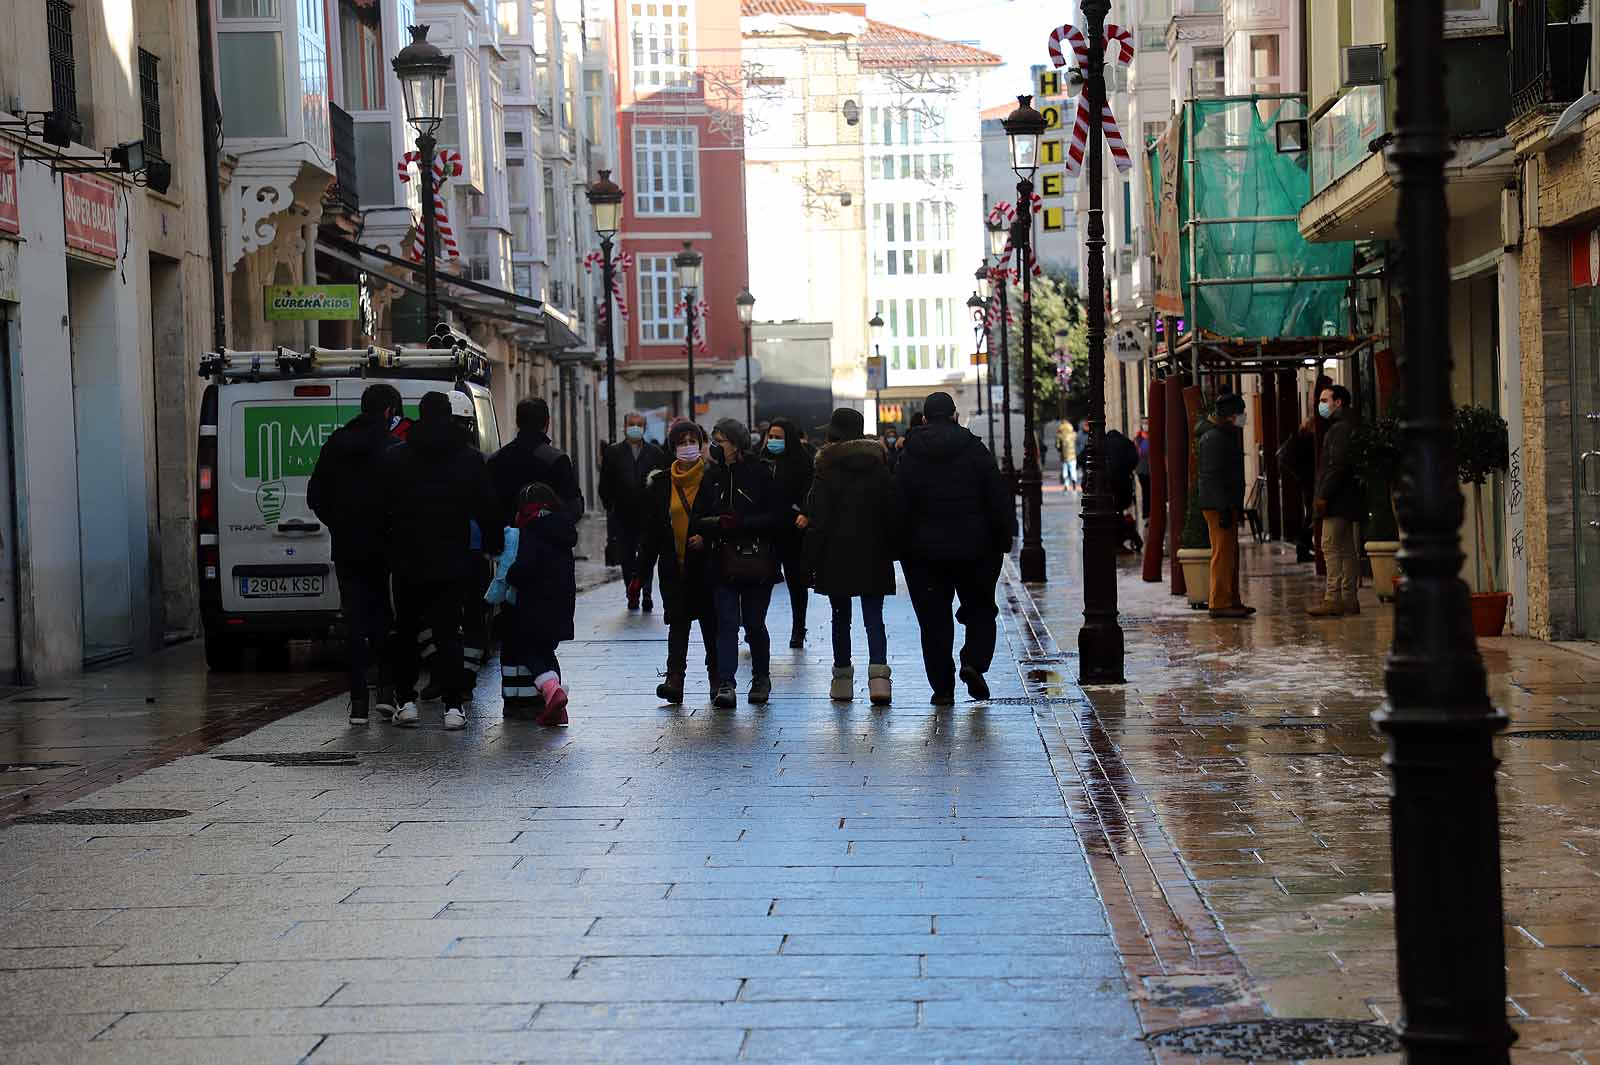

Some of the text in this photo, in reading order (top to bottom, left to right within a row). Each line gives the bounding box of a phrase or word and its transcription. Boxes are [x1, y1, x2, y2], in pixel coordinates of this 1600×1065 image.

[1040, 72, 1062, 230] HOTEL
[0, 171, 15, 206] AR
[65, 190, 116, 234] SUPER BAZAR
[274, 298, 321, 309] EUREKA
[250, 578, 320, 593] 2904 KSC
